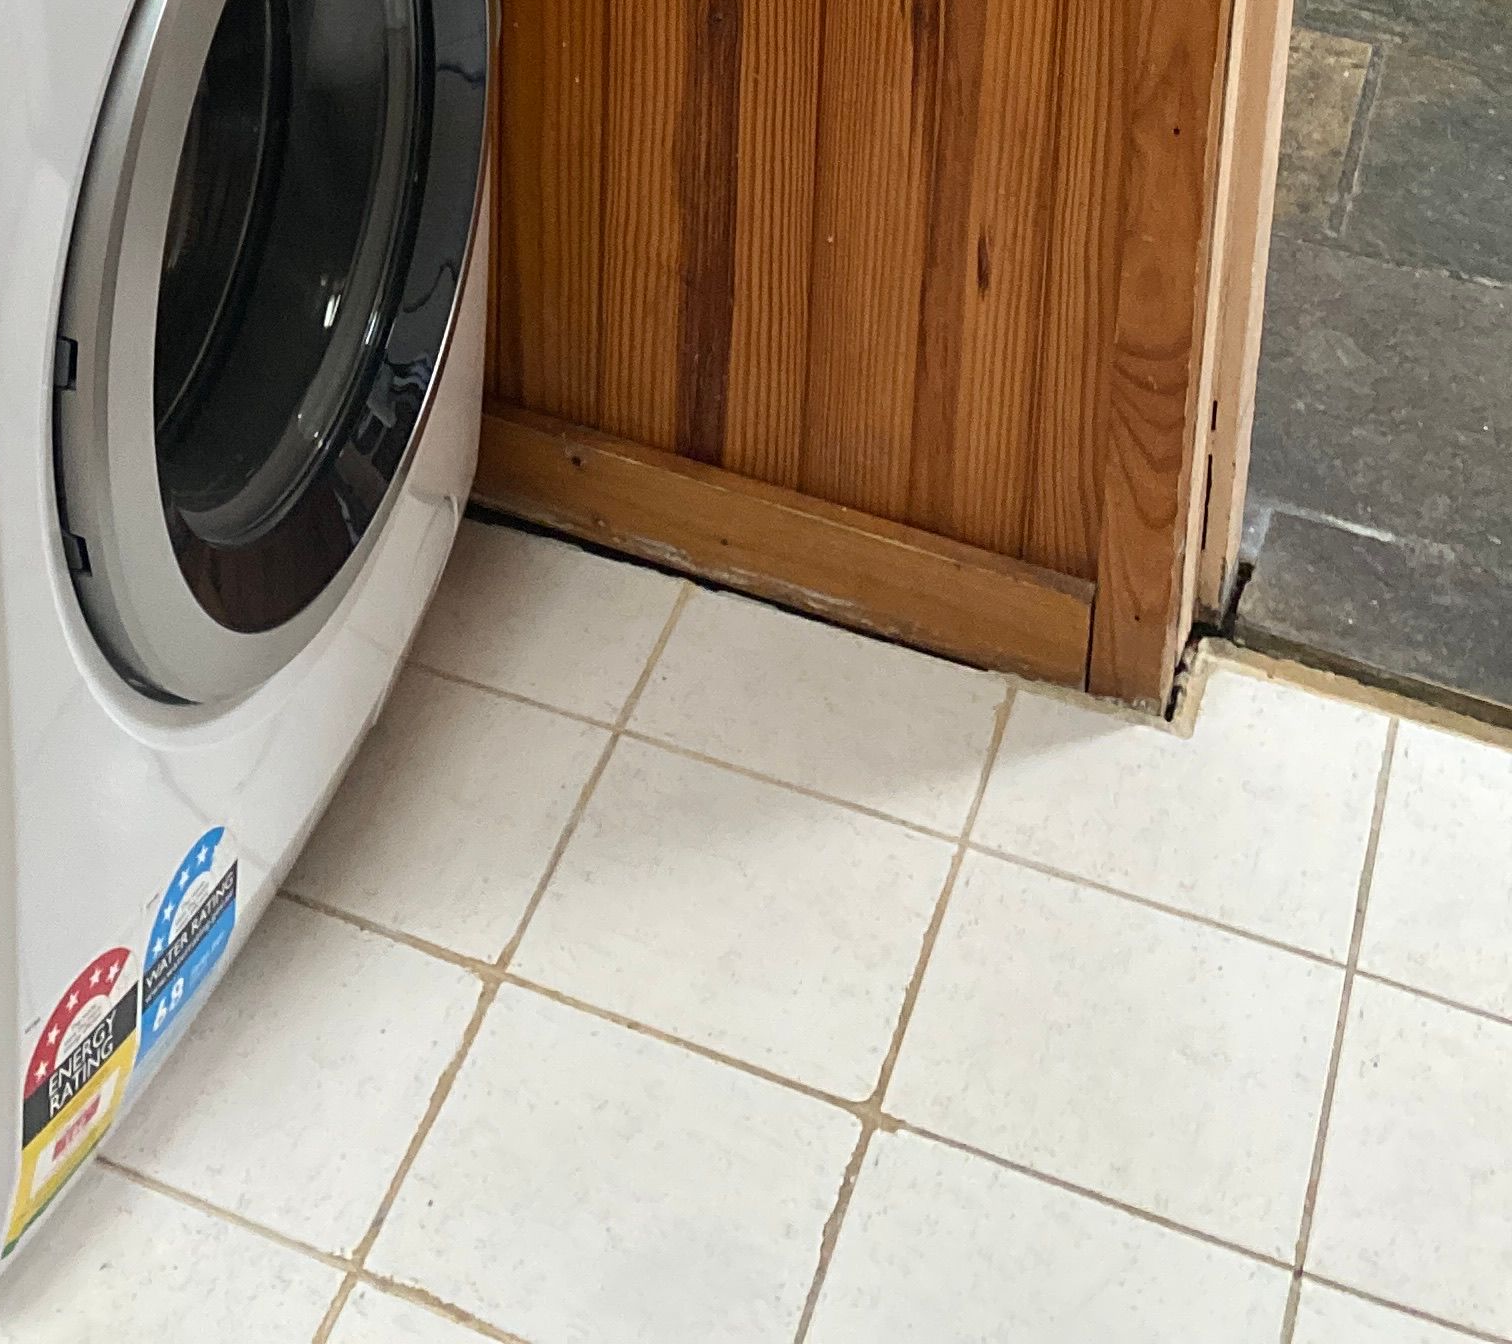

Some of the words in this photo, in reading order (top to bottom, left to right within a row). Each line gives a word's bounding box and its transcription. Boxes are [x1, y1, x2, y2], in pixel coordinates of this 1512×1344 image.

[145, 931, 188, 989] WATER
[191, 870, 234, 936] RATING
[152, 977, 185, 1032] 68
[49, 1009, 117, 1096] ENERGY
[50, 1035, 114, 1118] RATING
